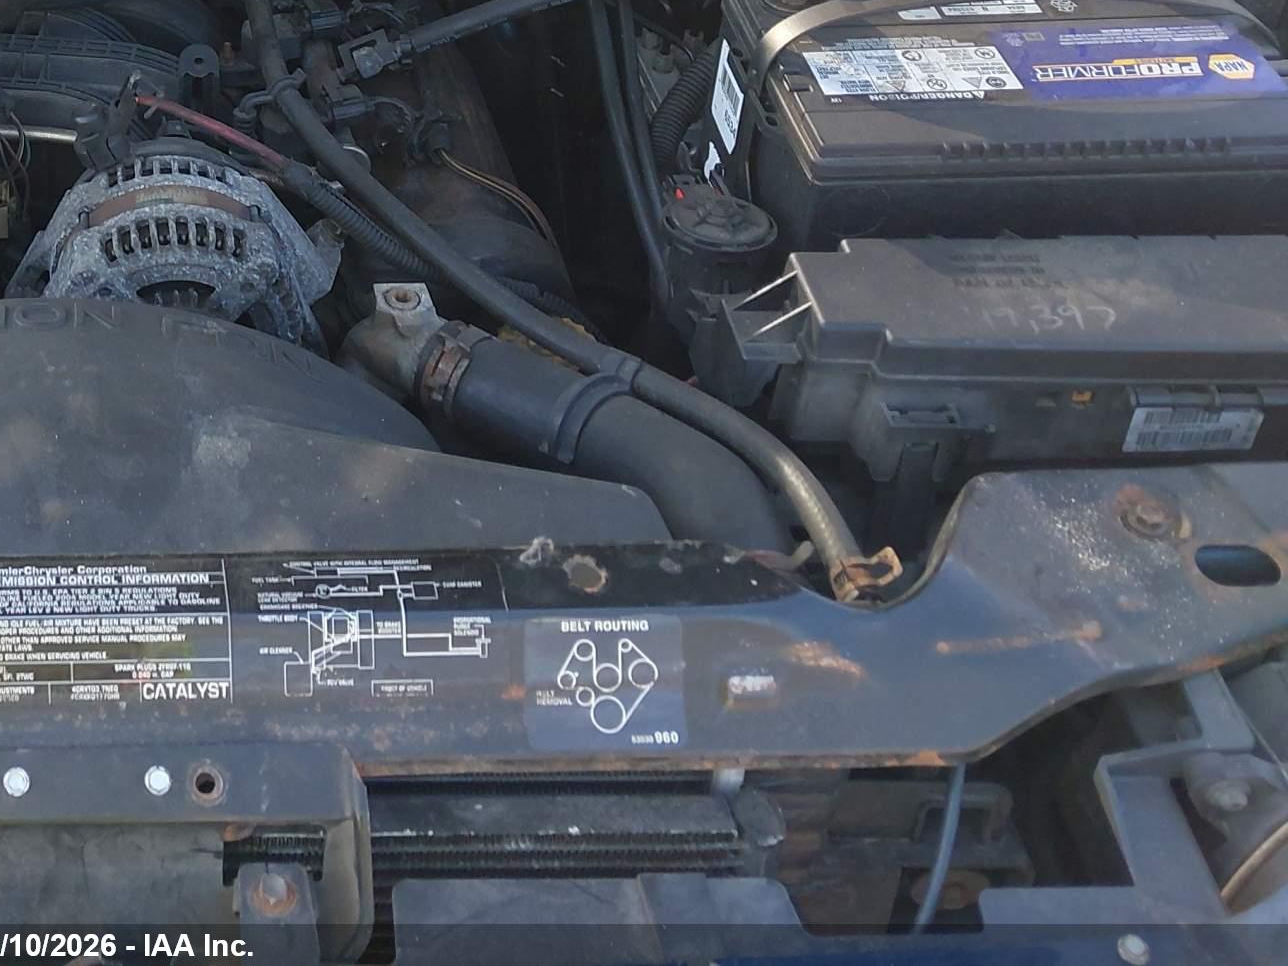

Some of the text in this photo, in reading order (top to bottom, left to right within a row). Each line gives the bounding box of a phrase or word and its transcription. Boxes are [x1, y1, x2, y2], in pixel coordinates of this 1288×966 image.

[1036, 60, 1248, 81] NAPA PROFORMER
[869, 91, 977, 101] DANGER/POISON
[77, 565, 147, 576] Corporation
[60, 574, 119, 585] CONTROL
[122, 573, 209, 584] INFORMATION
[122, 586, 177, 594] REGULATIONS
[53, 606, 72, 614] NEW
[55, 618, 82, 627] MIXTURE
[83, 618, 100, 626] HAVE
[101, 618, 118, 626] BEEN
[144, 617, 152, 625] AT
[154, 617, 165, 625] THE
[561, 620, 649, 632] BELT ROUTING
[19, 627, 59, 635] PROCEDURES
[60, 626, 74, 634] AND
[75, 626, 96, 634] OTHER
[97, 625, 133, 633] ADDITIONAL
[0, 636, 20, 644] OTHER
[21, 635, 39, 644] THAN
[40, 635, 72, 643] APPROVED
[74, 634, 100, 643] SERVICE
[101, 634, 128, 642] MANUAL
[129, 633, 170, 642] PROCEDURES
[171, 633, 186, 642] MAY
[5, 652, 24, 661] BRAKE
[26, 652, 46, 661] WHEN
[47, 651, 80, 660] SERVICING
[142, 682, 229, 700] CATALYST
